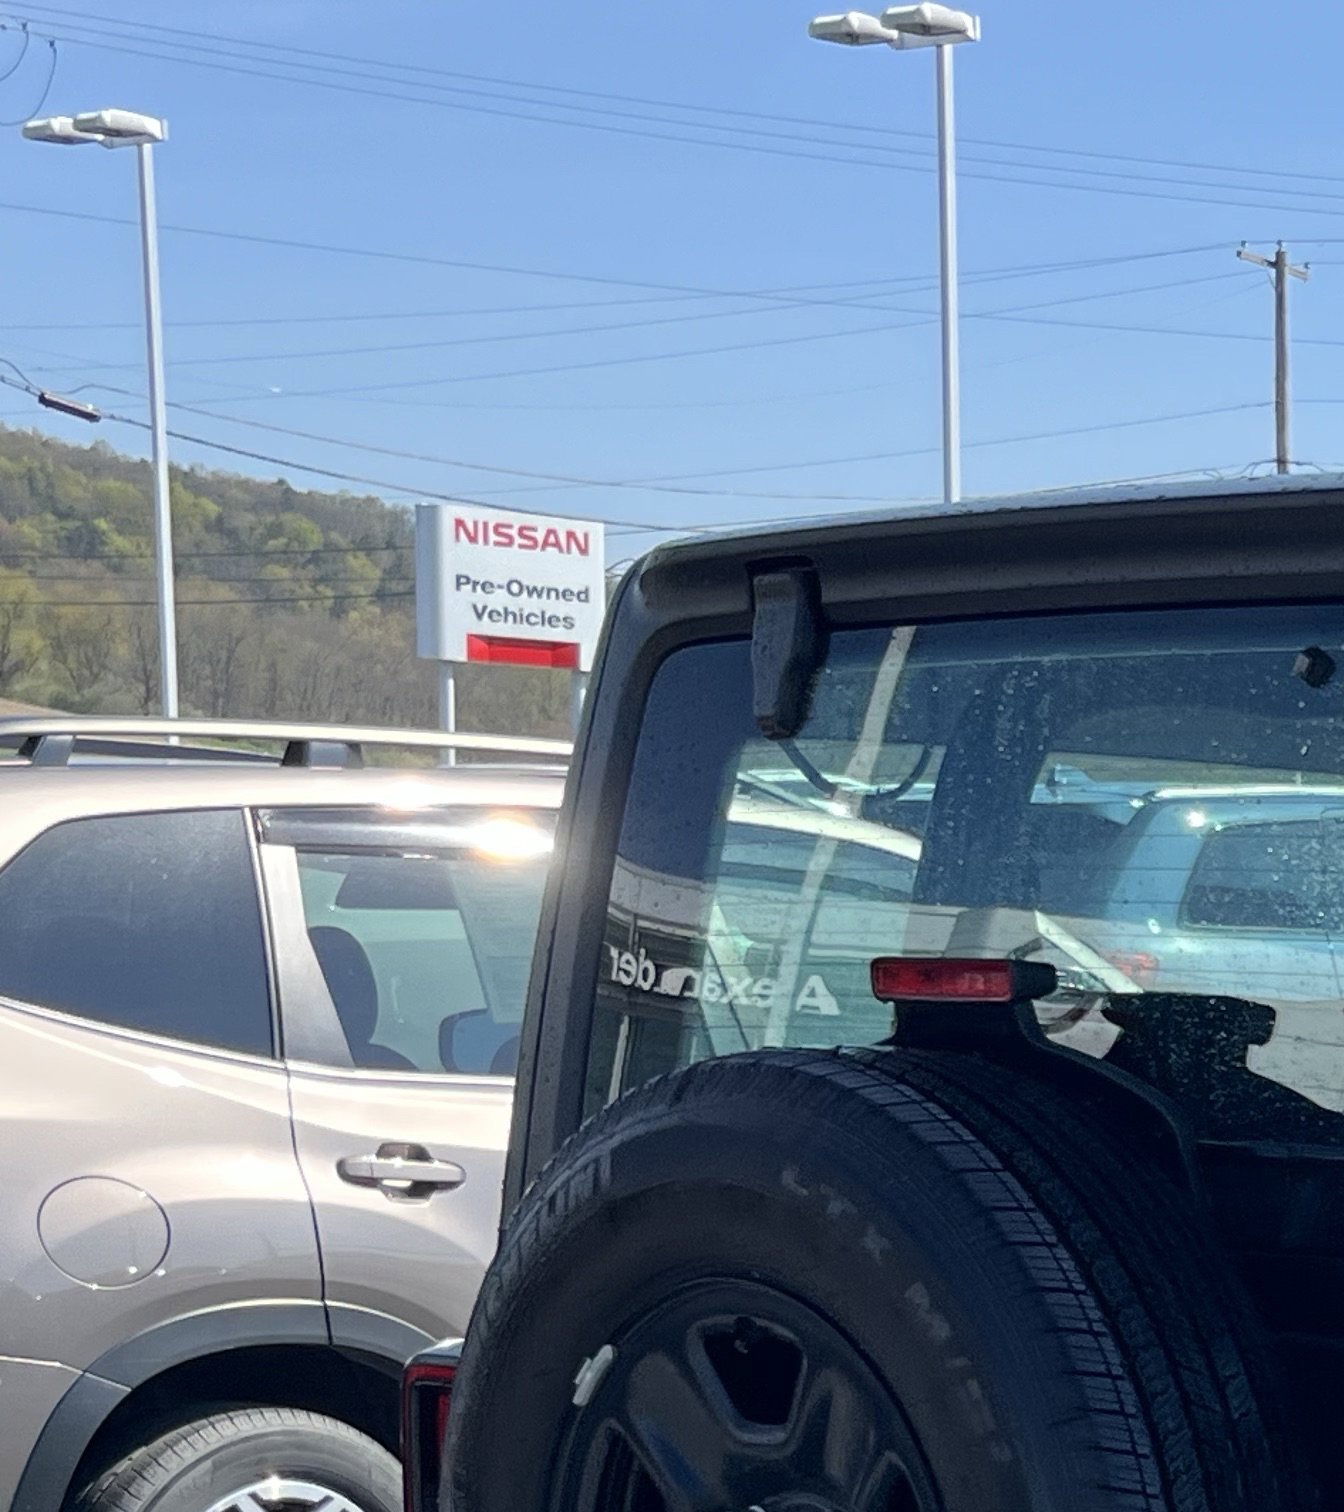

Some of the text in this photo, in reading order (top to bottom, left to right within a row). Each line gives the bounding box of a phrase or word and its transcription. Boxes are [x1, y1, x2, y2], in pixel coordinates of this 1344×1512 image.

[454, 517, 590, 557] NISSAN
[455, 573, 591, 604] Pre-Owned
[471, 603, 576, 630] Vehicles
